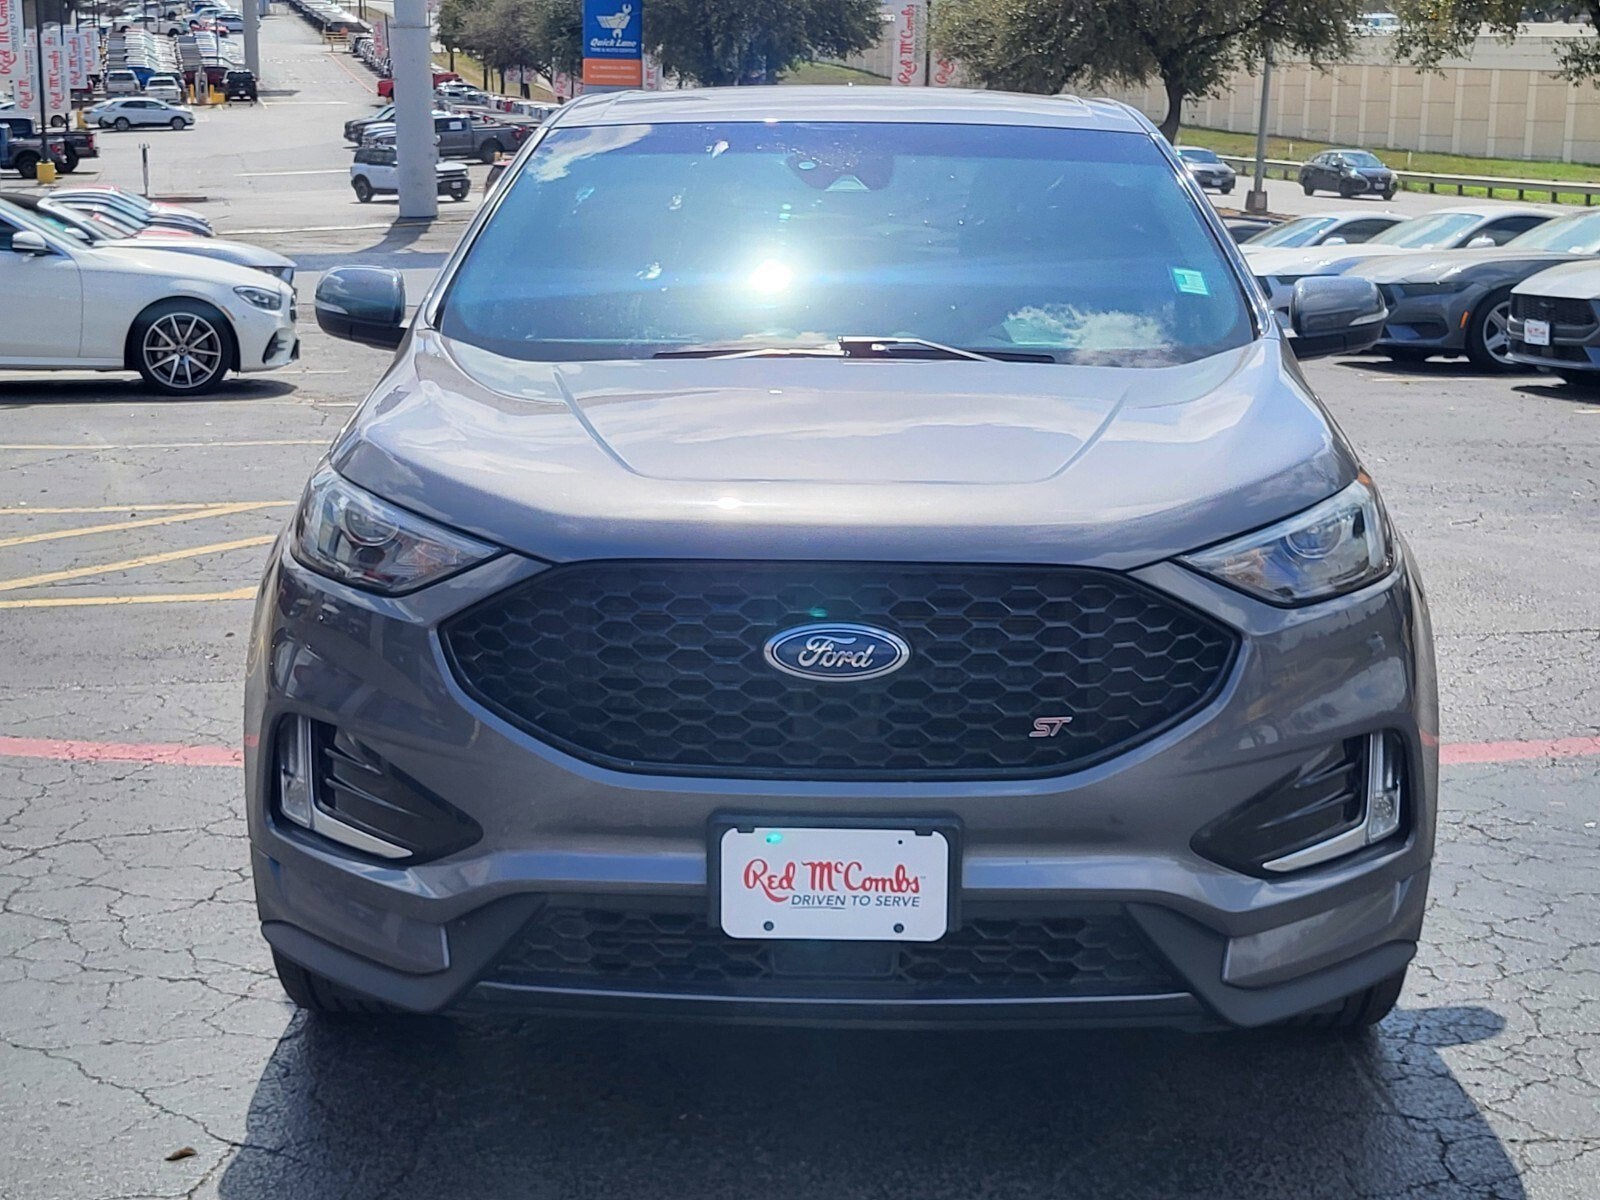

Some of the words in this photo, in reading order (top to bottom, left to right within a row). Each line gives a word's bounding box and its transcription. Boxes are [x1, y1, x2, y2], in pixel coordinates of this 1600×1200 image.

[590, 38, 615, 47] Quick
[616, 39, 637, 47] Lane
[899, 60, 917, 84] Red
[798, 635, 876, 668] Ford
[1028, 716, 1073, 737] ST
[744, 858, 796, 903] Red
[801, 861, 920, 893] McCombs
[791, 894, 846, 906] DRIVEN
[851, 895, 870, 907] TO
[874, 895, 921, 908] SERVE
